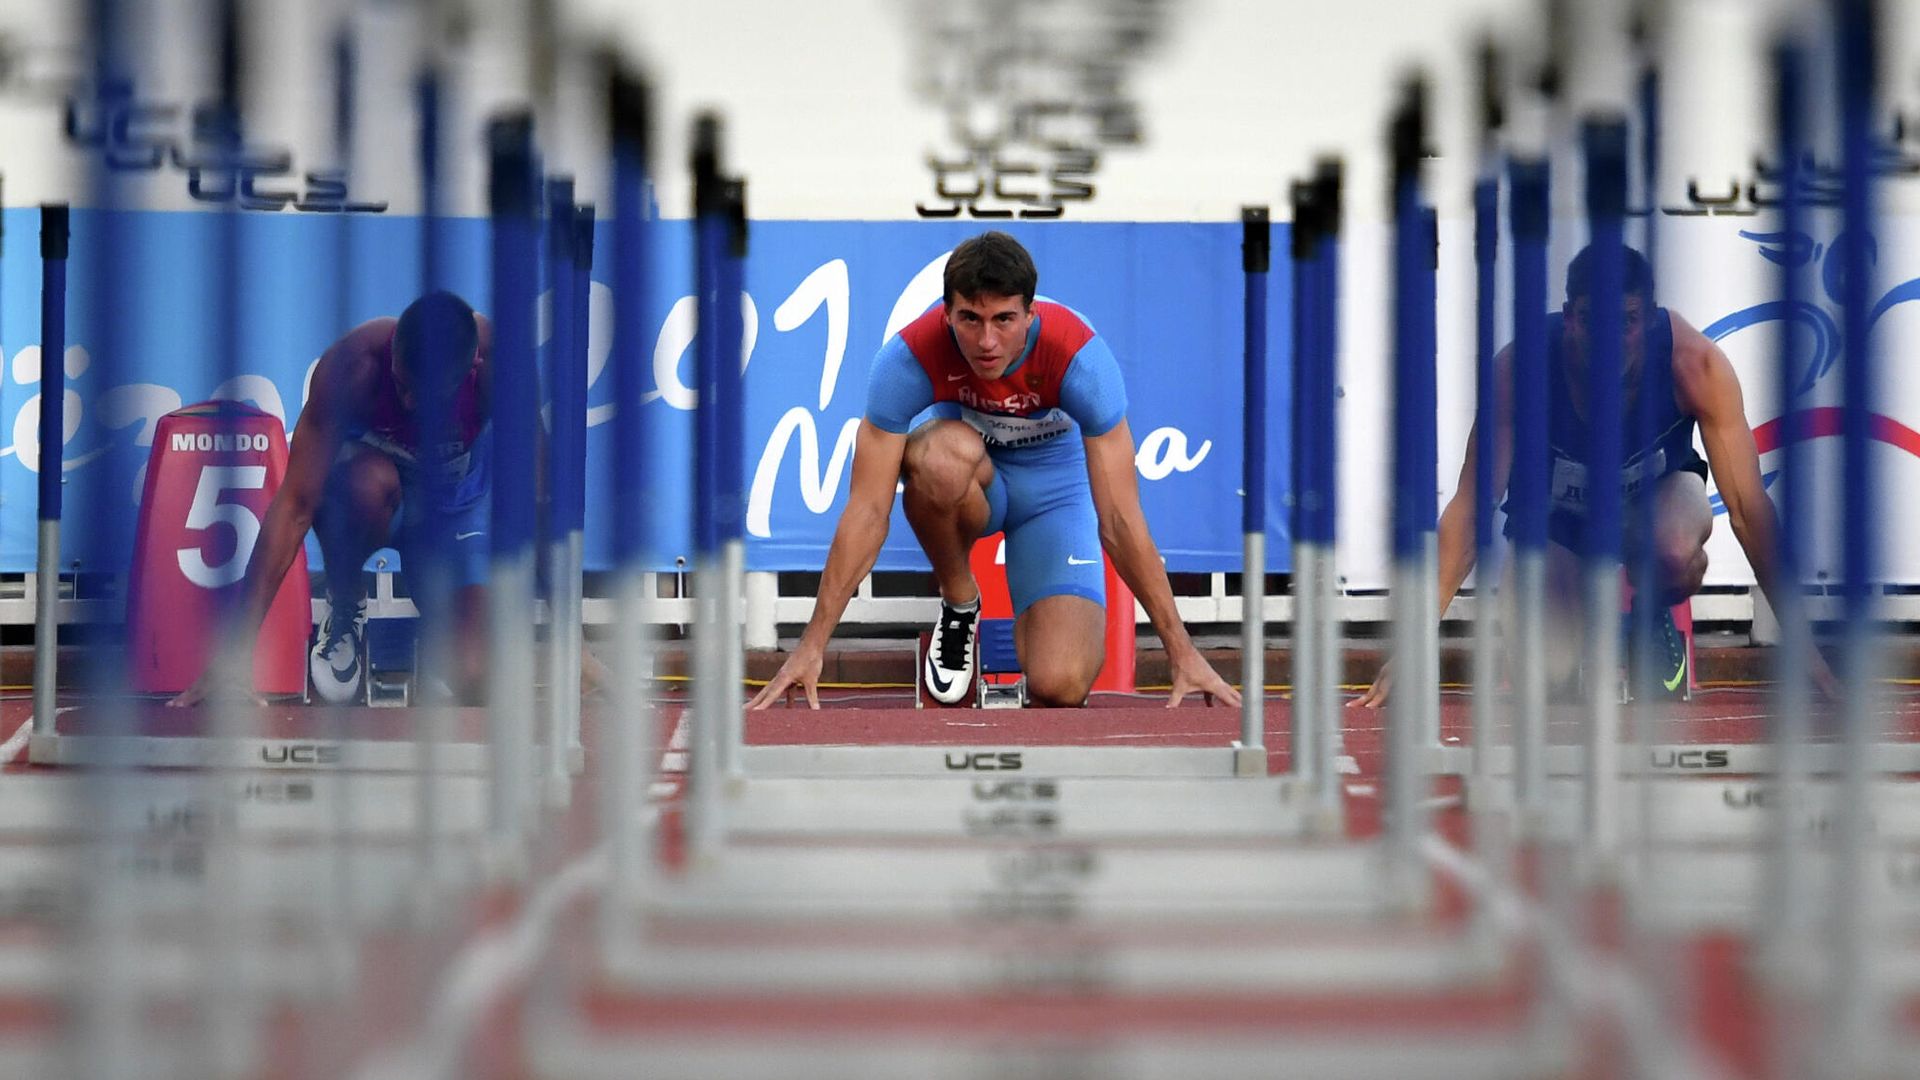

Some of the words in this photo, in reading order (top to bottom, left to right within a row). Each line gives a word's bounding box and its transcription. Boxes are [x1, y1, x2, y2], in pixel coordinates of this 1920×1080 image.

[172, 433, 269, 452] MONDO
[176, 465, 267, 588] 5
[262, 745, 342, 763] UCS
[945, 752, 1022, 770] UCS
[1650, 750, 1729, 769] UCS
